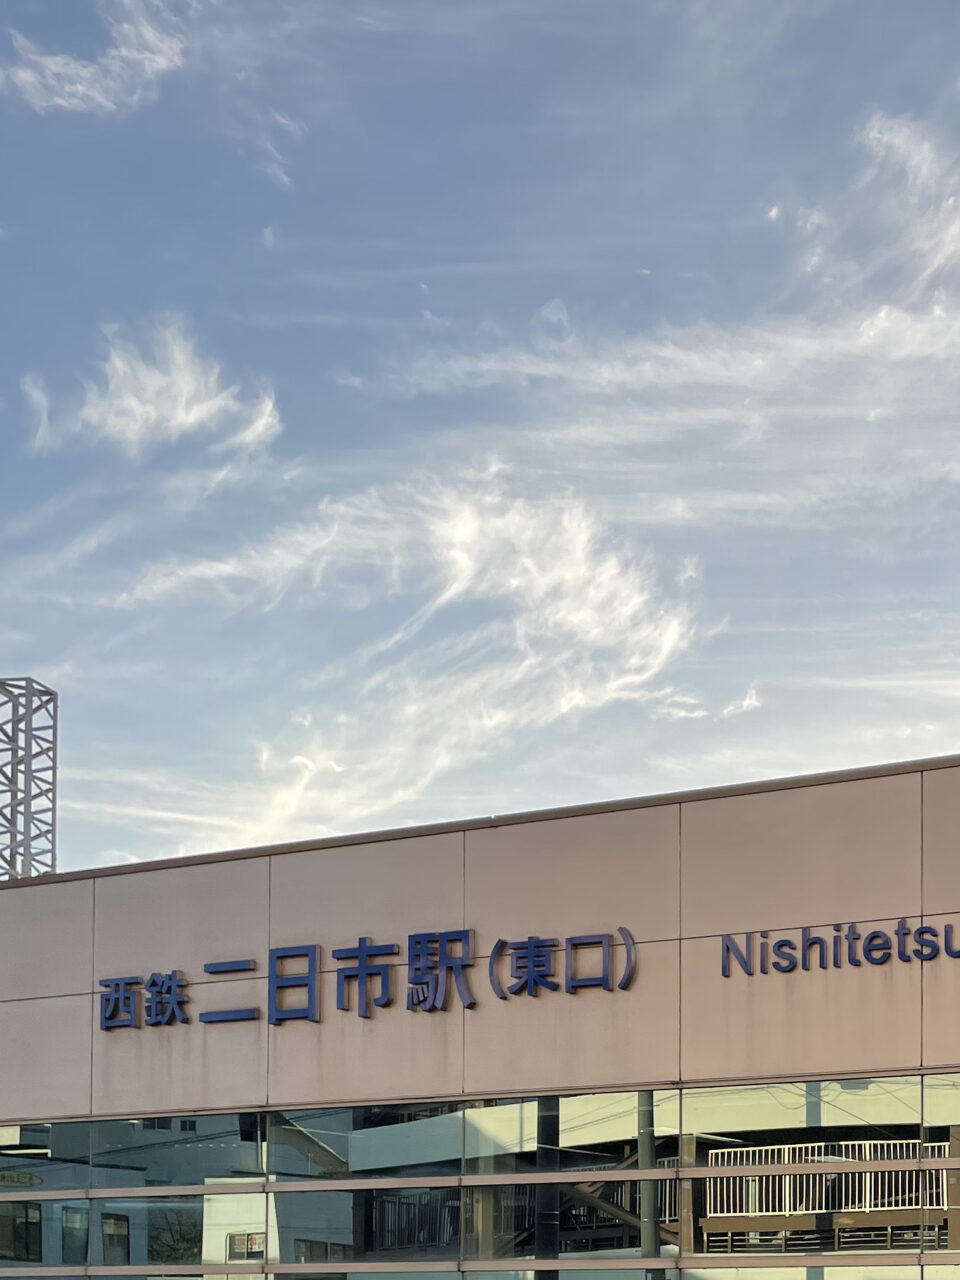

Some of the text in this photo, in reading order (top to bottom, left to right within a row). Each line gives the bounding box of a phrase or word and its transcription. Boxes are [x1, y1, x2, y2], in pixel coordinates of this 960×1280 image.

[99, 926, 638, 1031] 西鉄二日市駅(東口)
